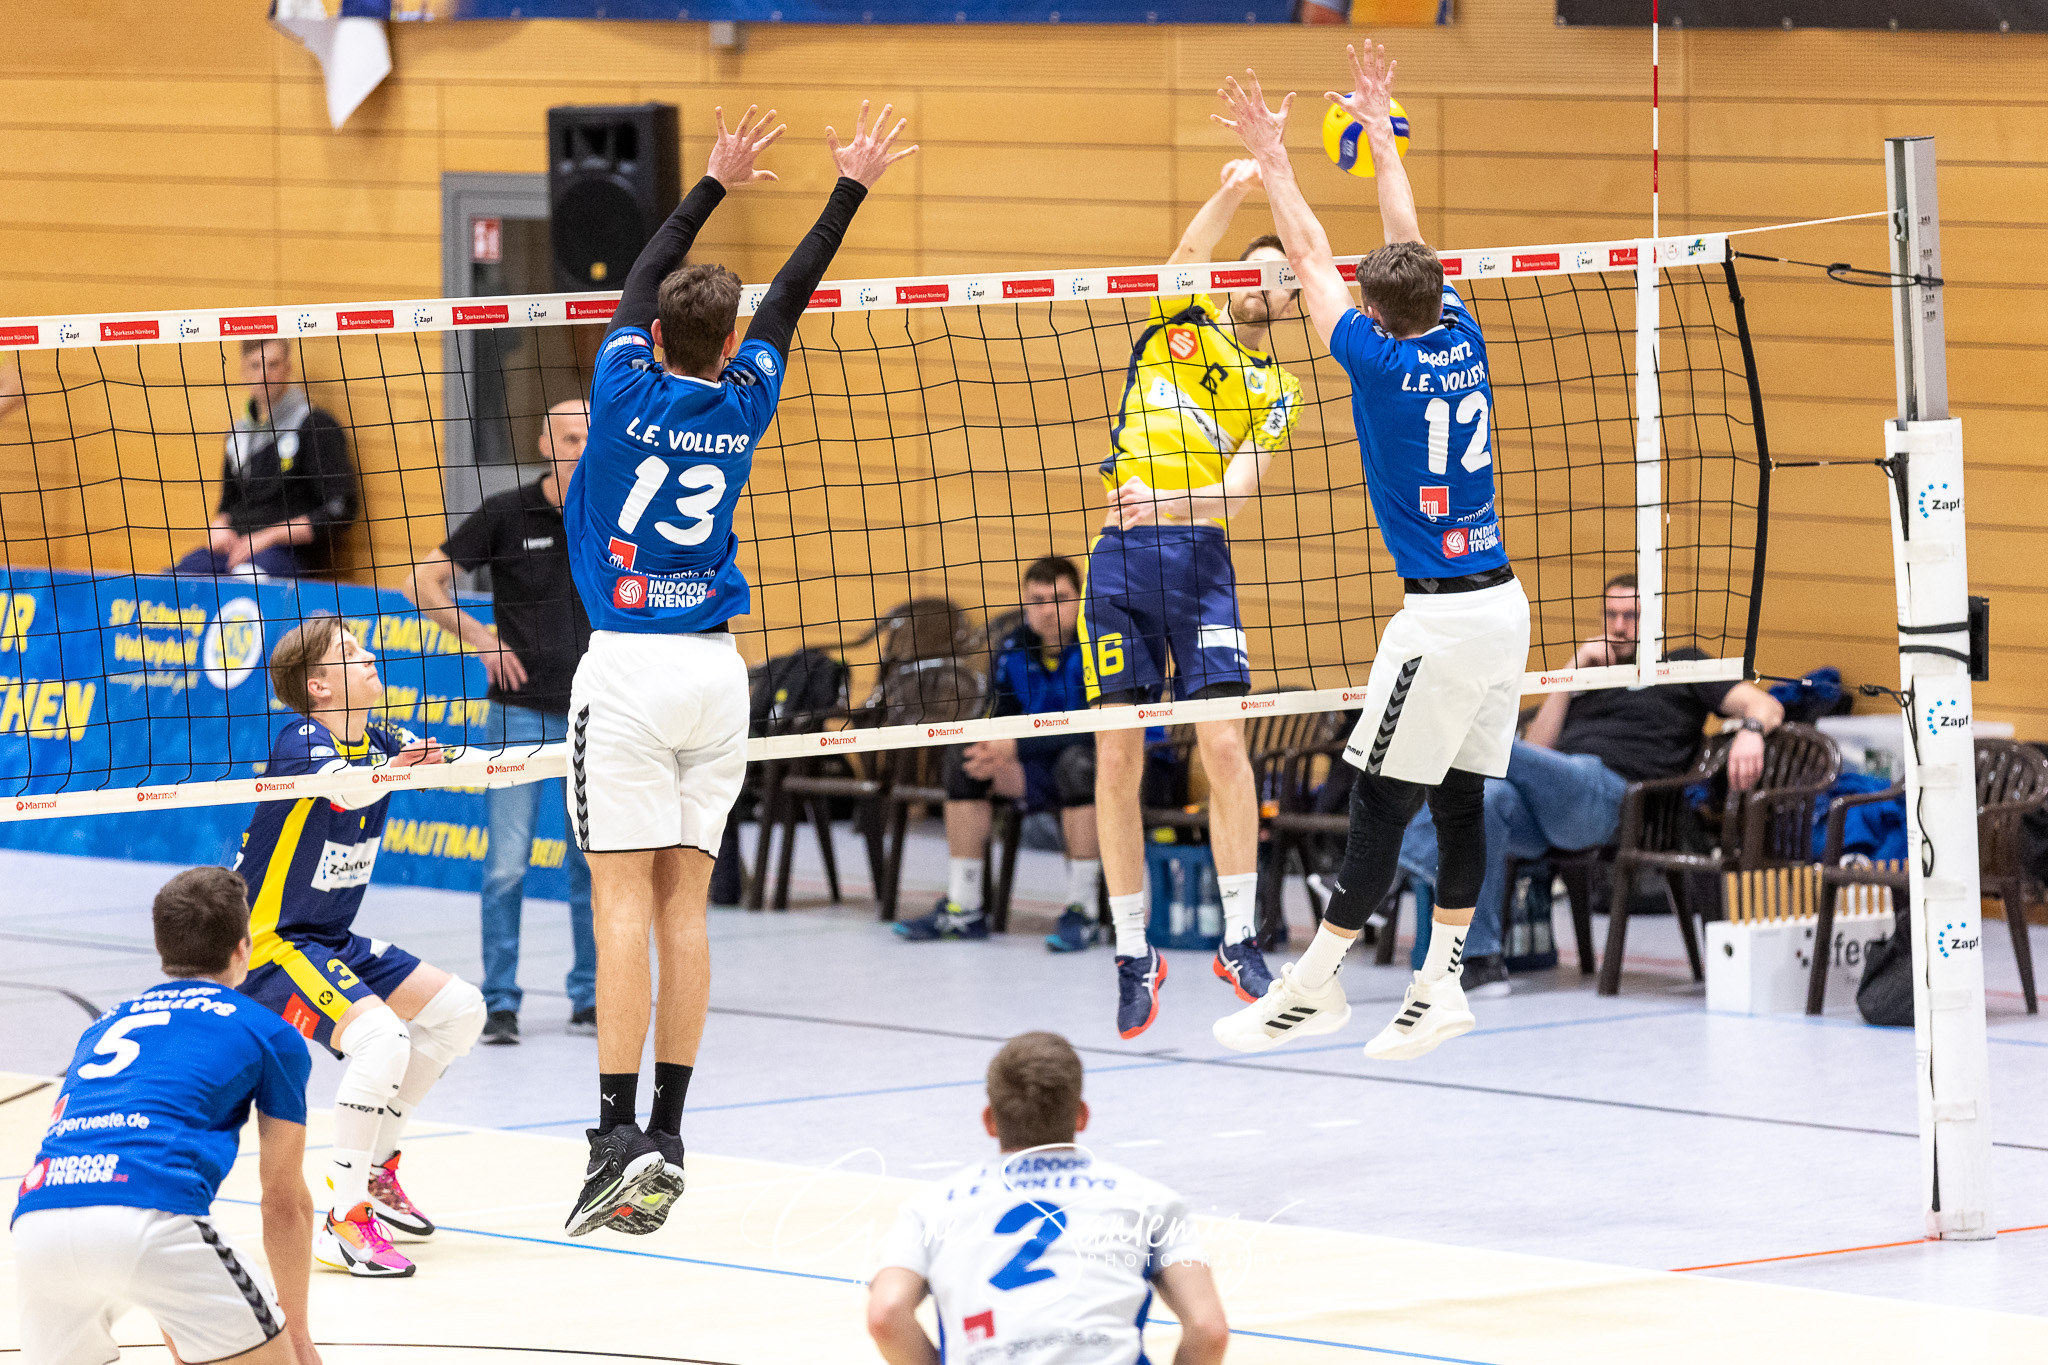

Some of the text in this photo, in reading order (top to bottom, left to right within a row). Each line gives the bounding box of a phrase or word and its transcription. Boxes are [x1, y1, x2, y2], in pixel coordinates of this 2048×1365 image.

[1181, 279, 1194, 287] Zapf
[1283, 274, 1296, 282] Zapf
[972, 289, 985, 297] Zapf
[1077, 284, 1090, 292] Zapf
[865, 294, 878, 302] Zapf
[533, 310, 547, 318] Zapf
[598, 307, 617, 315] Nürnber
[303, 321, 317, 329] Zapf
[419, 316, 433, 324] Zapf
[185, 326, 200, 334] Zapf
[66, 331, 80, 340] Zapf
[1401, 372, 1435, 392] L.E.
[626, 416, 750, 455] L.E. VOLLEYS
[1424, 390, 1492, 475] 12
[617, 455, 727, 546] 13
[1931, 498, 1961, 512] Zapf
[648, 579, 708, 596] INDOOR
[647, 593, 707, 608] TRENDS
[1097, 632, 1125, 677] 6
[1547, 675, 1574, 685] Marmot
[0, 675, 97, 743] HEN
[1248, 699, 1276, 709] Marmot
[1145, 708, 1173, 718] Marmot
[1041, 718, 1070, 728] Marmot
[1940, 714, 1968, 728] Zapf
[935, 727, 964, 737] Marmot
[828, 736, 857, 746] Marmot
[494, 763, 525, 774] Marmot
[380, 773, 411, 783] Marmot
[264, 781, 295, 792] Marmot
[145, 791, 177, 801] Marmot
[25, 800, 57, 810] Marmot
[1951, 936, 1979, 951] Zapf
[326, 958, 360, 991] 3
[77, 1011, 171, 1080] 5
[48, 1153, 120, 1173] INDOOR
[45, 1168, 115, 1188] TRENDS
[989, 1199, 1068, 1292] 2
